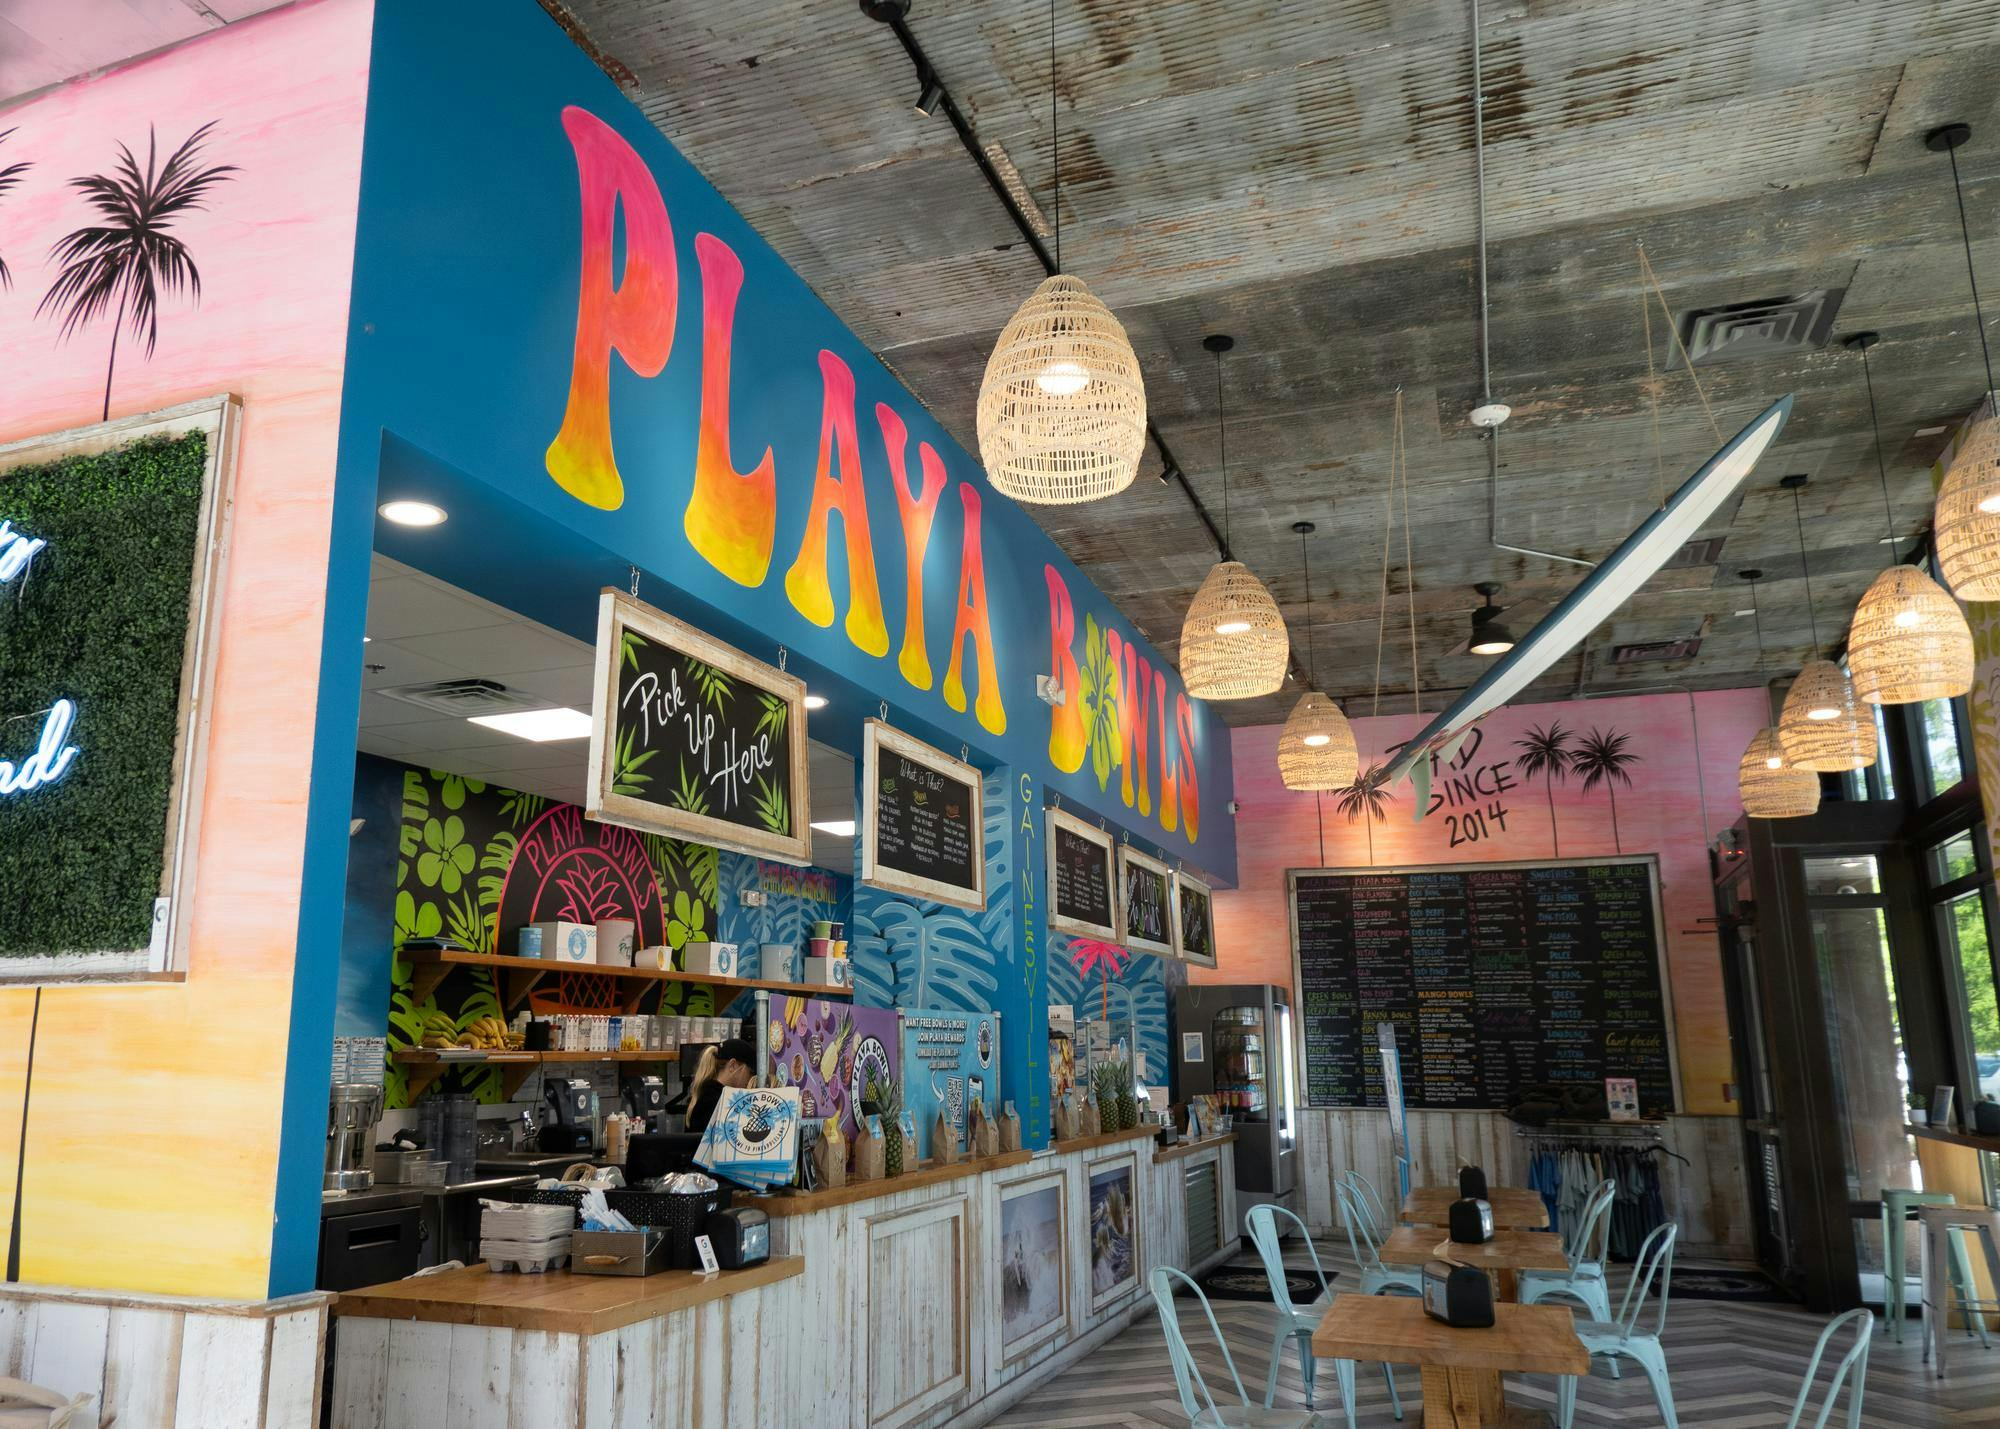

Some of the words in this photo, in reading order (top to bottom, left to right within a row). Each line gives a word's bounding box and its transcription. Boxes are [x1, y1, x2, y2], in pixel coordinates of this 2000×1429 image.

[545, 104, 1006, 735] PLAYA
[623, 668, 686, 747] Pick
[684, 712, 715, 774] Up
[710, 727, 773, 815] Here
[900, 758, 917, 782] What
[926, 771, 944, 793] That?
[1445, 800, 1508, 848] 2014
[525, 806, 584, 878] PLAYA
[599, 823, 656, 910] BOWLS
[1529, 869, 1576, 880] SMOOTHIES
[1587, 867, 1610, 877] FRESH
[1615, 866, 1645, 876] JUICES
[1020, 773, 1040, 1139] GAINESVILLE
[1307, 991, 1328, 1001] GREEN
[1332, 992, 1353, 1000] BOWLS
[1418, 991, 1447, 999] MANGO
[905, 1018, 919, 1028] WANT
[920, 1018, 932, 1028] FREE
[932, 1019, 948, 1028] BOWLS
[952, 1020, 967, 1029] MORE?
[918, 1032, 929, 1042] JOIN
[929, 1033, 943, 1042] PLAYA
[944, 1034, 965, 1043] REWARDS
[854, 1044, 870, 1081] PLAYA
[873, 1041, 889, 1081] BOWLS
[734, 1095, 759, 1114] PLAYA
[760, 1094, 786, 1113] BOWLS
